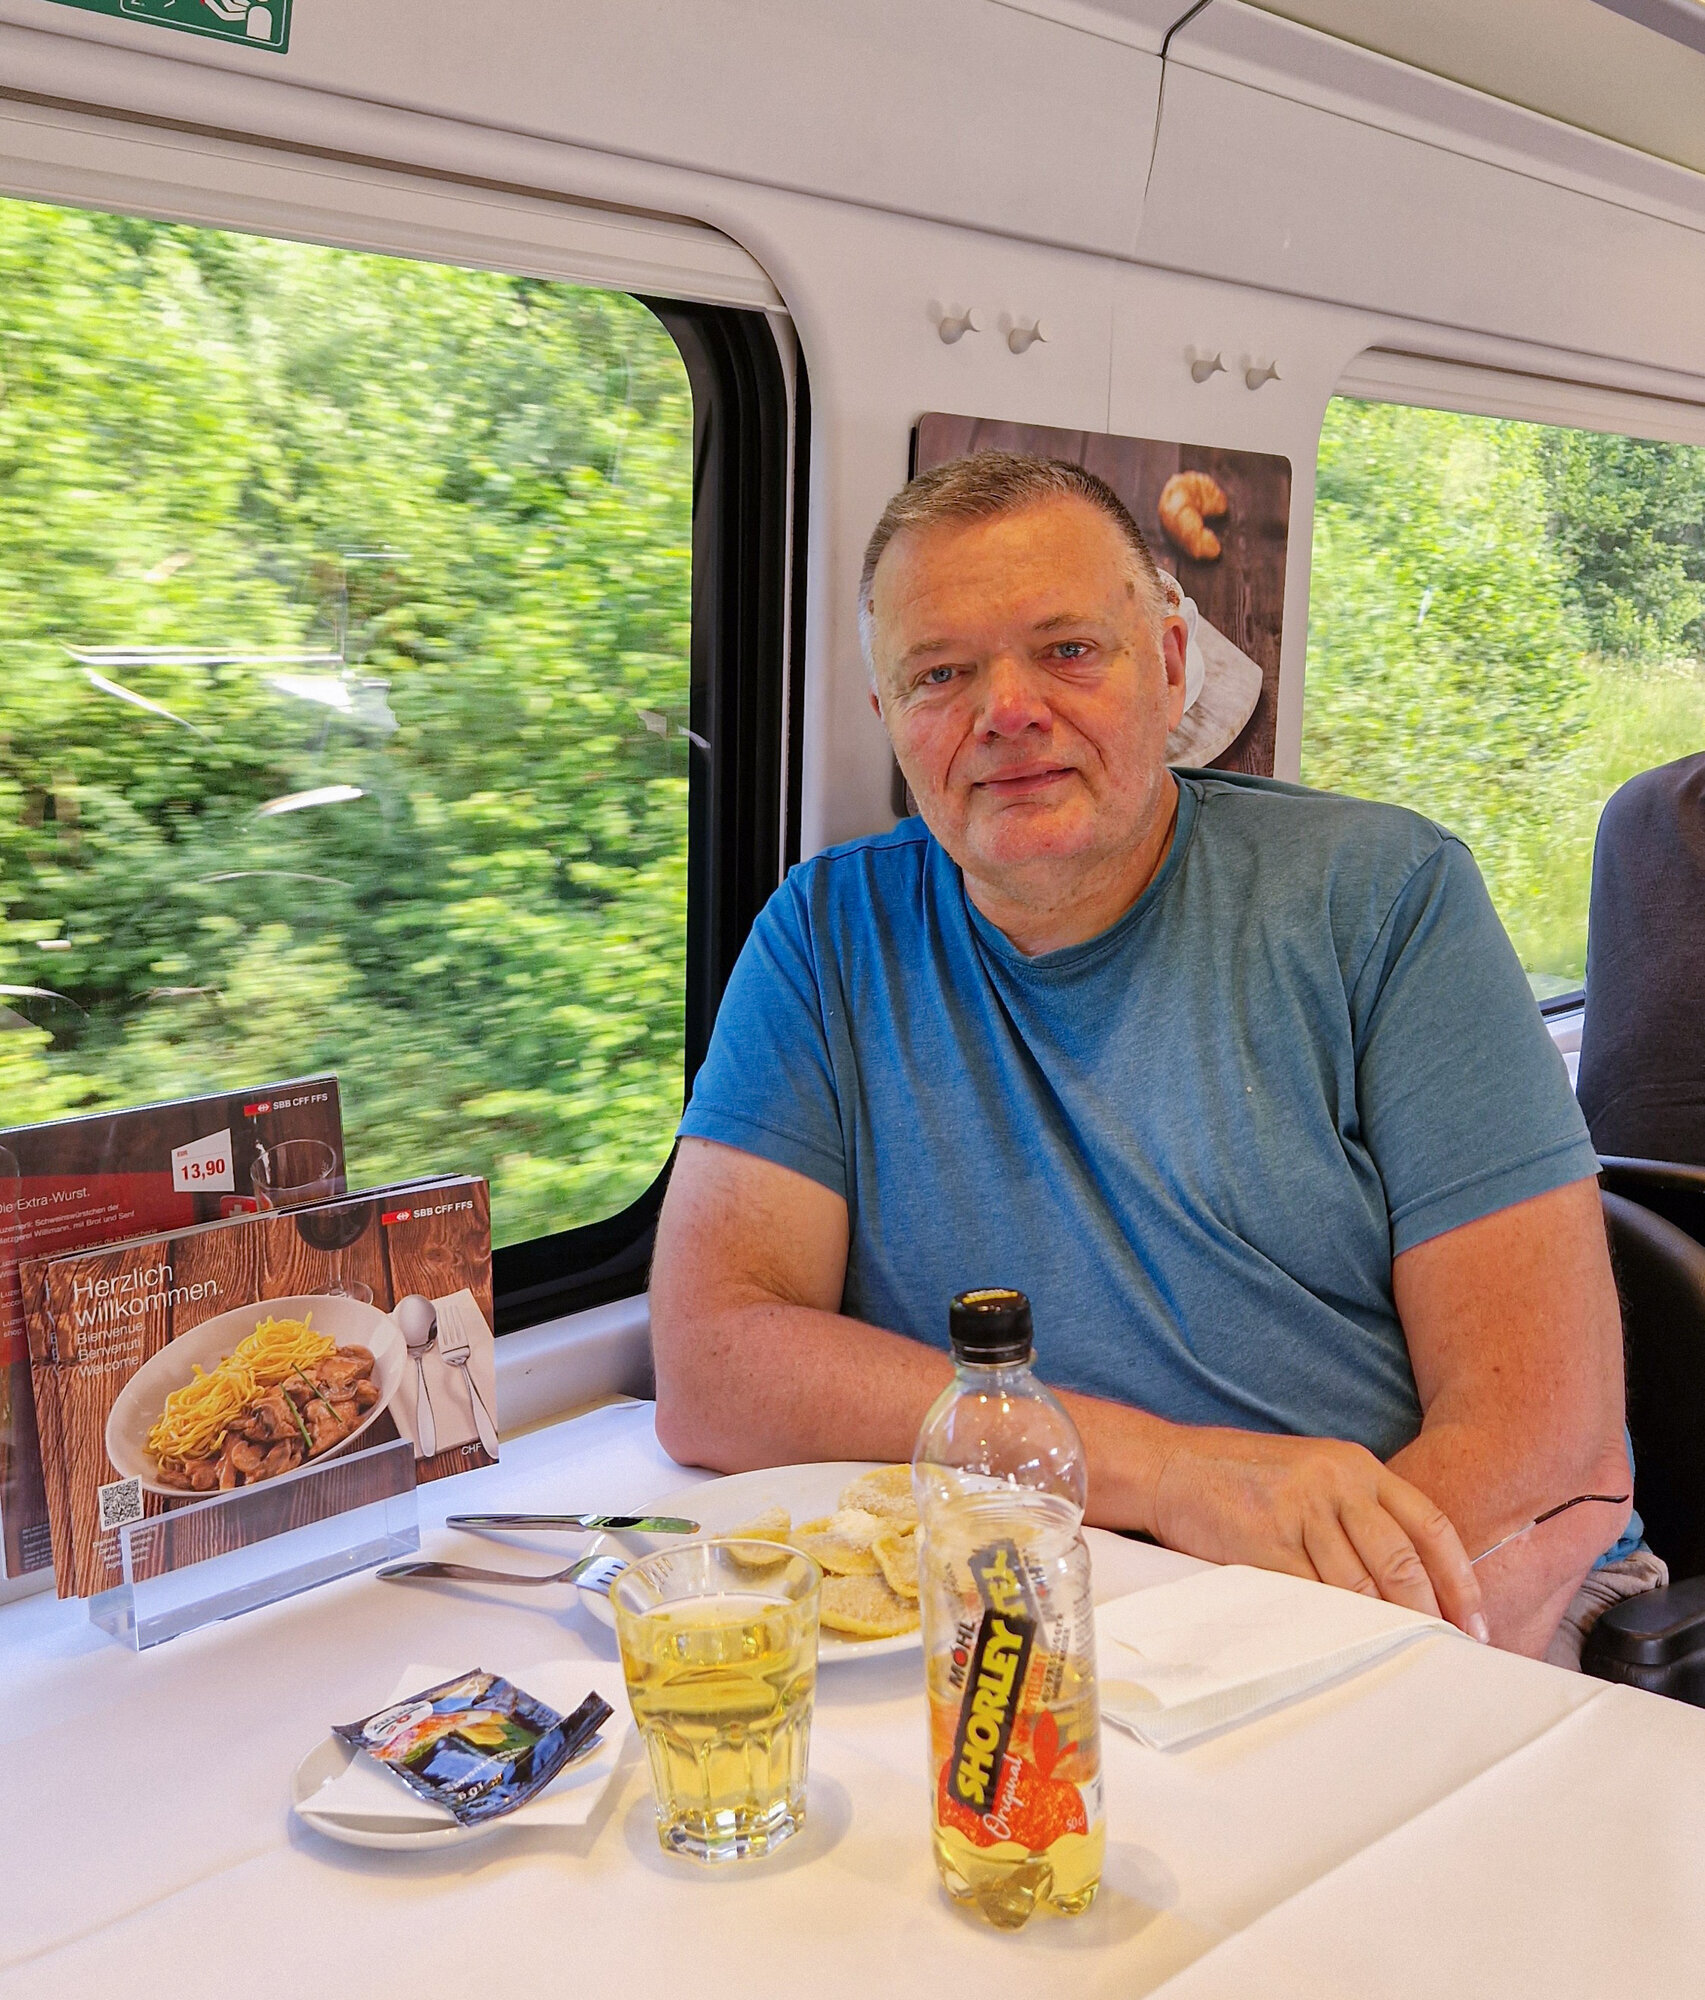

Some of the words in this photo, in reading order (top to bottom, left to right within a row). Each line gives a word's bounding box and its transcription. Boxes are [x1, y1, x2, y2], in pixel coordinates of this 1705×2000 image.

[272, 1098, 291, 1110] SBB
[292, 1095, 310, 1107] CFF
[311, 1092, 328, 1104] FFS
[181, 1158, 226, 1181] 13,90
[17, 1187, 91, 1210] Extra-Wurst.
[413, 1207, 433, 1219] SBB
[434, 1203, 454, 1215] CFF
[455, 1200, 474, 1211] FFS
[73, 1262, 174, 1304] Herzlich
[75, 1279, 224, 1328] willkommen.
[461, 1442, 482, 1456] CHF
[956, 1618, 1024, 1806] SHORLEY
[983, 1752, 1024, 1840] Original
